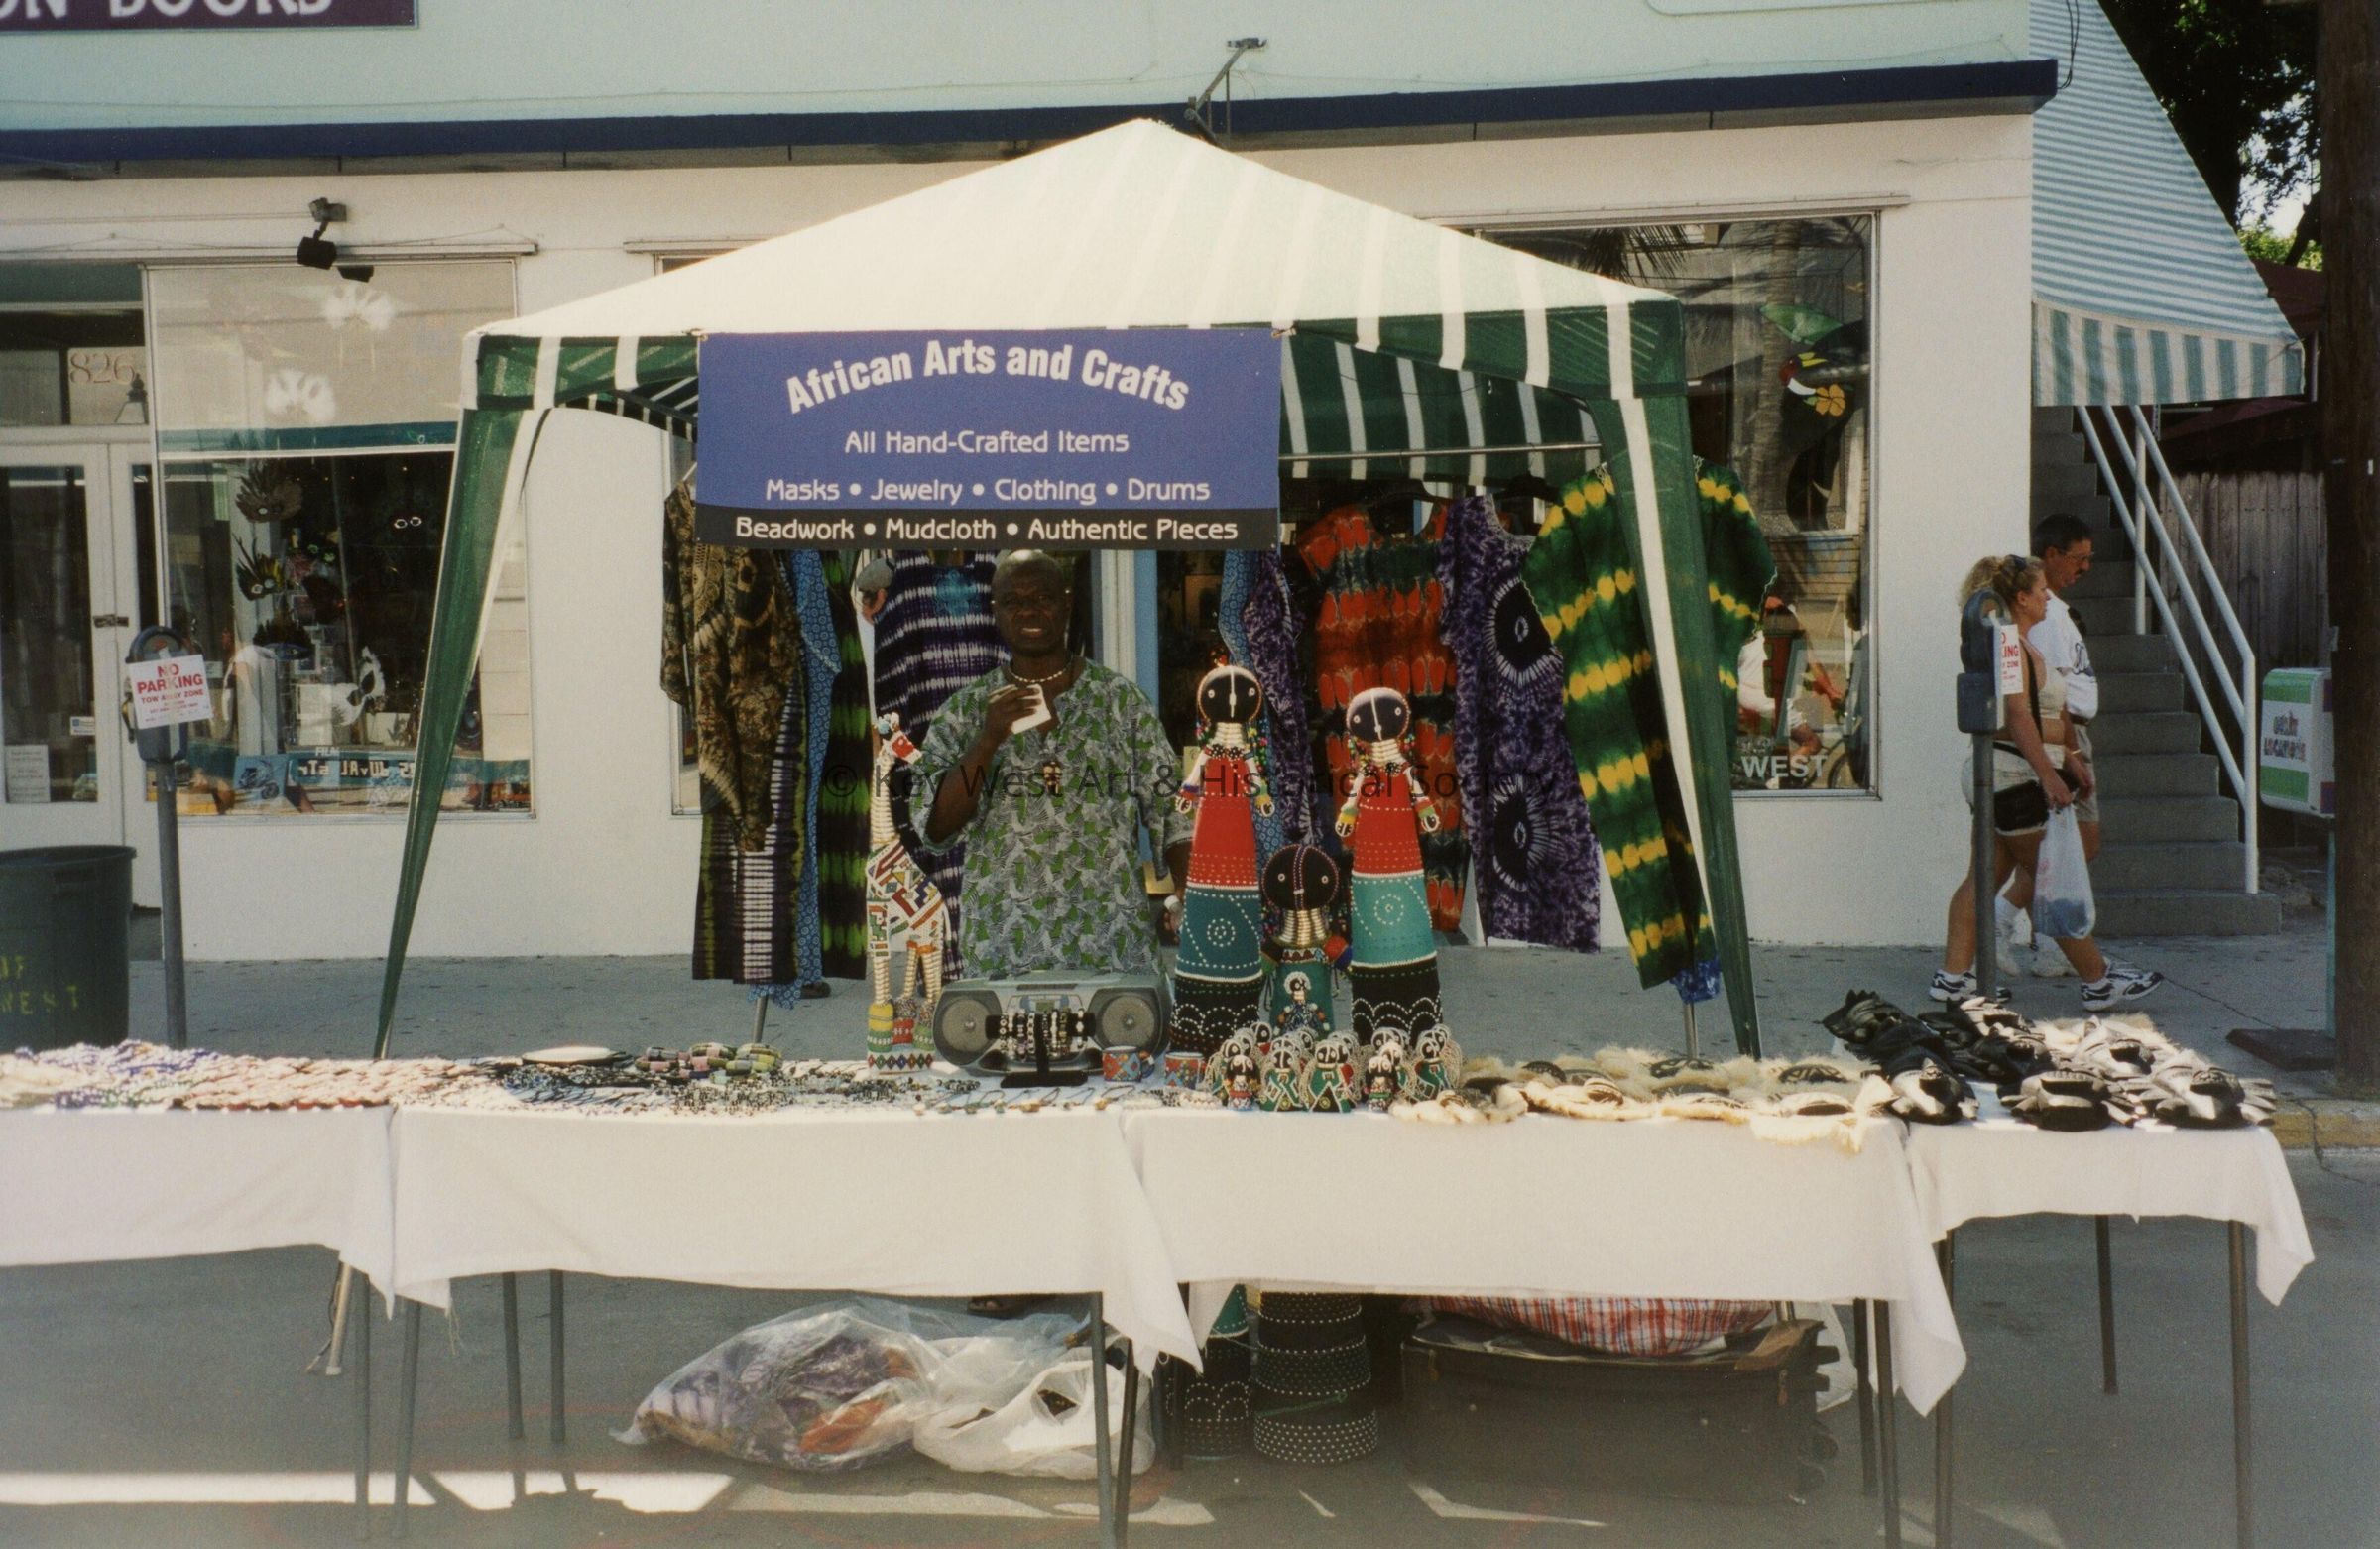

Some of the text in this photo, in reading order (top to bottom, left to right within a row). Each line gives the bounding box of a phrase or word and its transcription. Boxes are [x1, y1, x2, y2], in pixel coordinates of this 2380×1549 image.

[70, 353, 135, 385] 826
[786, 339, 1189, 414] African Arts and Crafts
[845, 430, 1129, 454] All Hand-Crafted Items
[766, 478, 1211, 506] Masks Jewelry Clothing Drums
[736, 517, 1239, 540] Beadwork Mudcloth Authentic Pieces
[157, 663, 179, 678] NO
[141, 695, 159, 705] TOW
[1740, 755, 1828, 778] WEST
